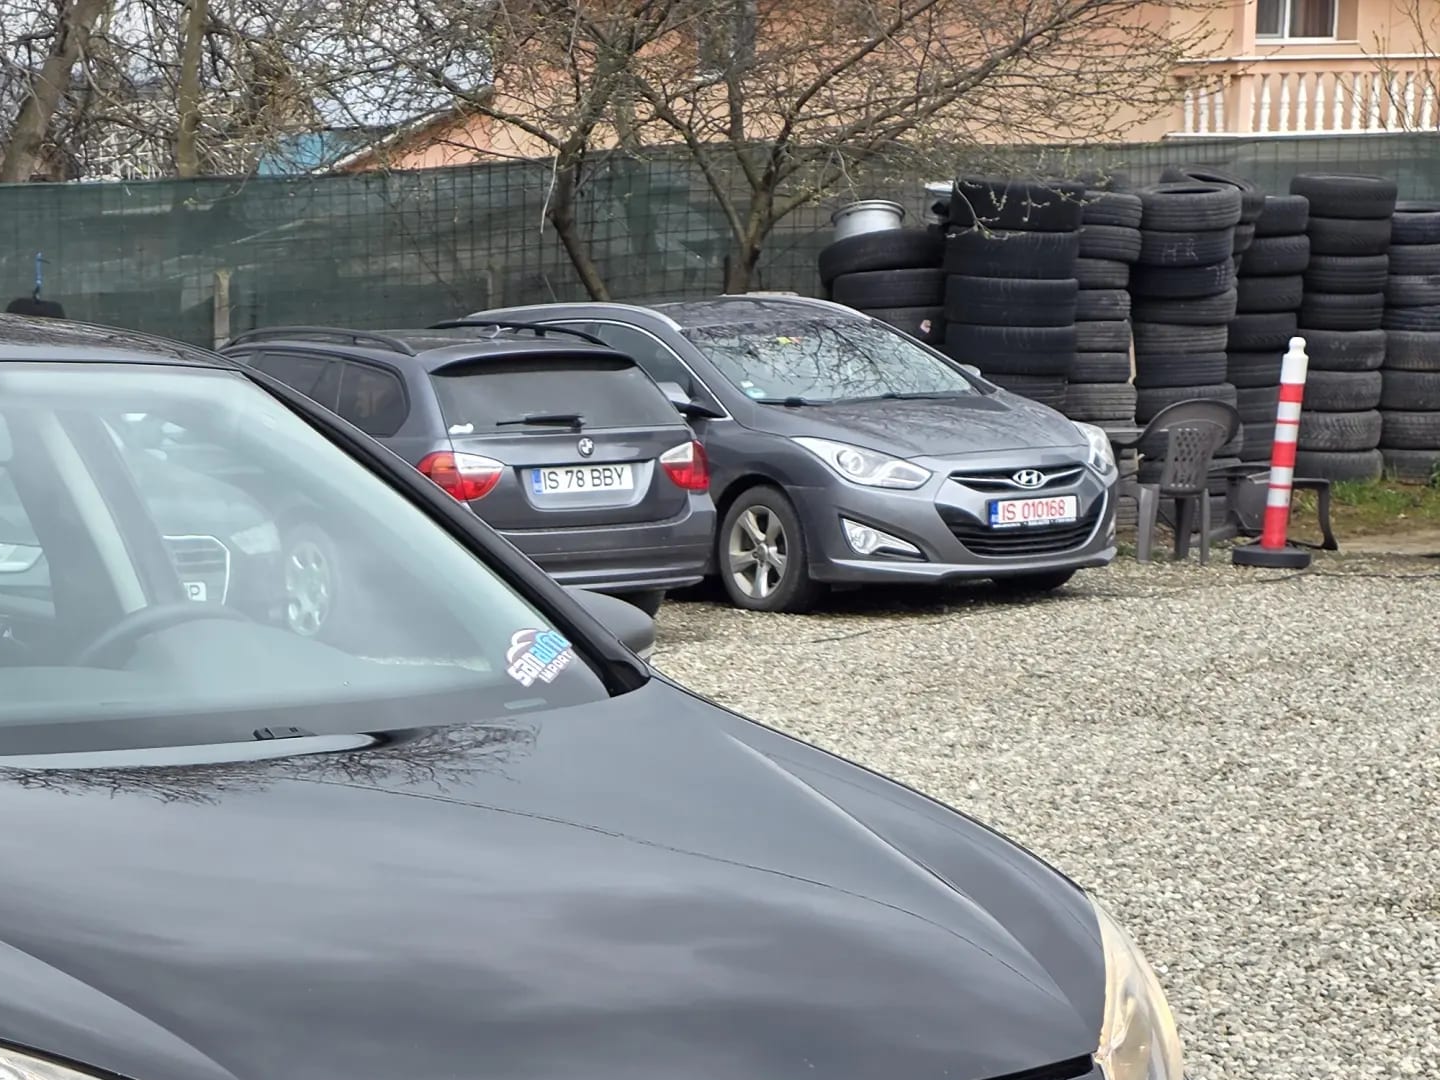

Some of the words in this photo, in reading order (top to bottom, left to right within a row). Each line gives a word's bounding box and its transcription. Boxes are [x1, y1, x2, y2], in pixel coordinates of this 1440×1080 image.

[543, 471, 559, 490] IS
[565, 470, 585, 488] 78
[590, 467, 624, 487] BBY
[1002, 503, 1016, 520] IS
[1022, 499, 1066, 519] 010168
